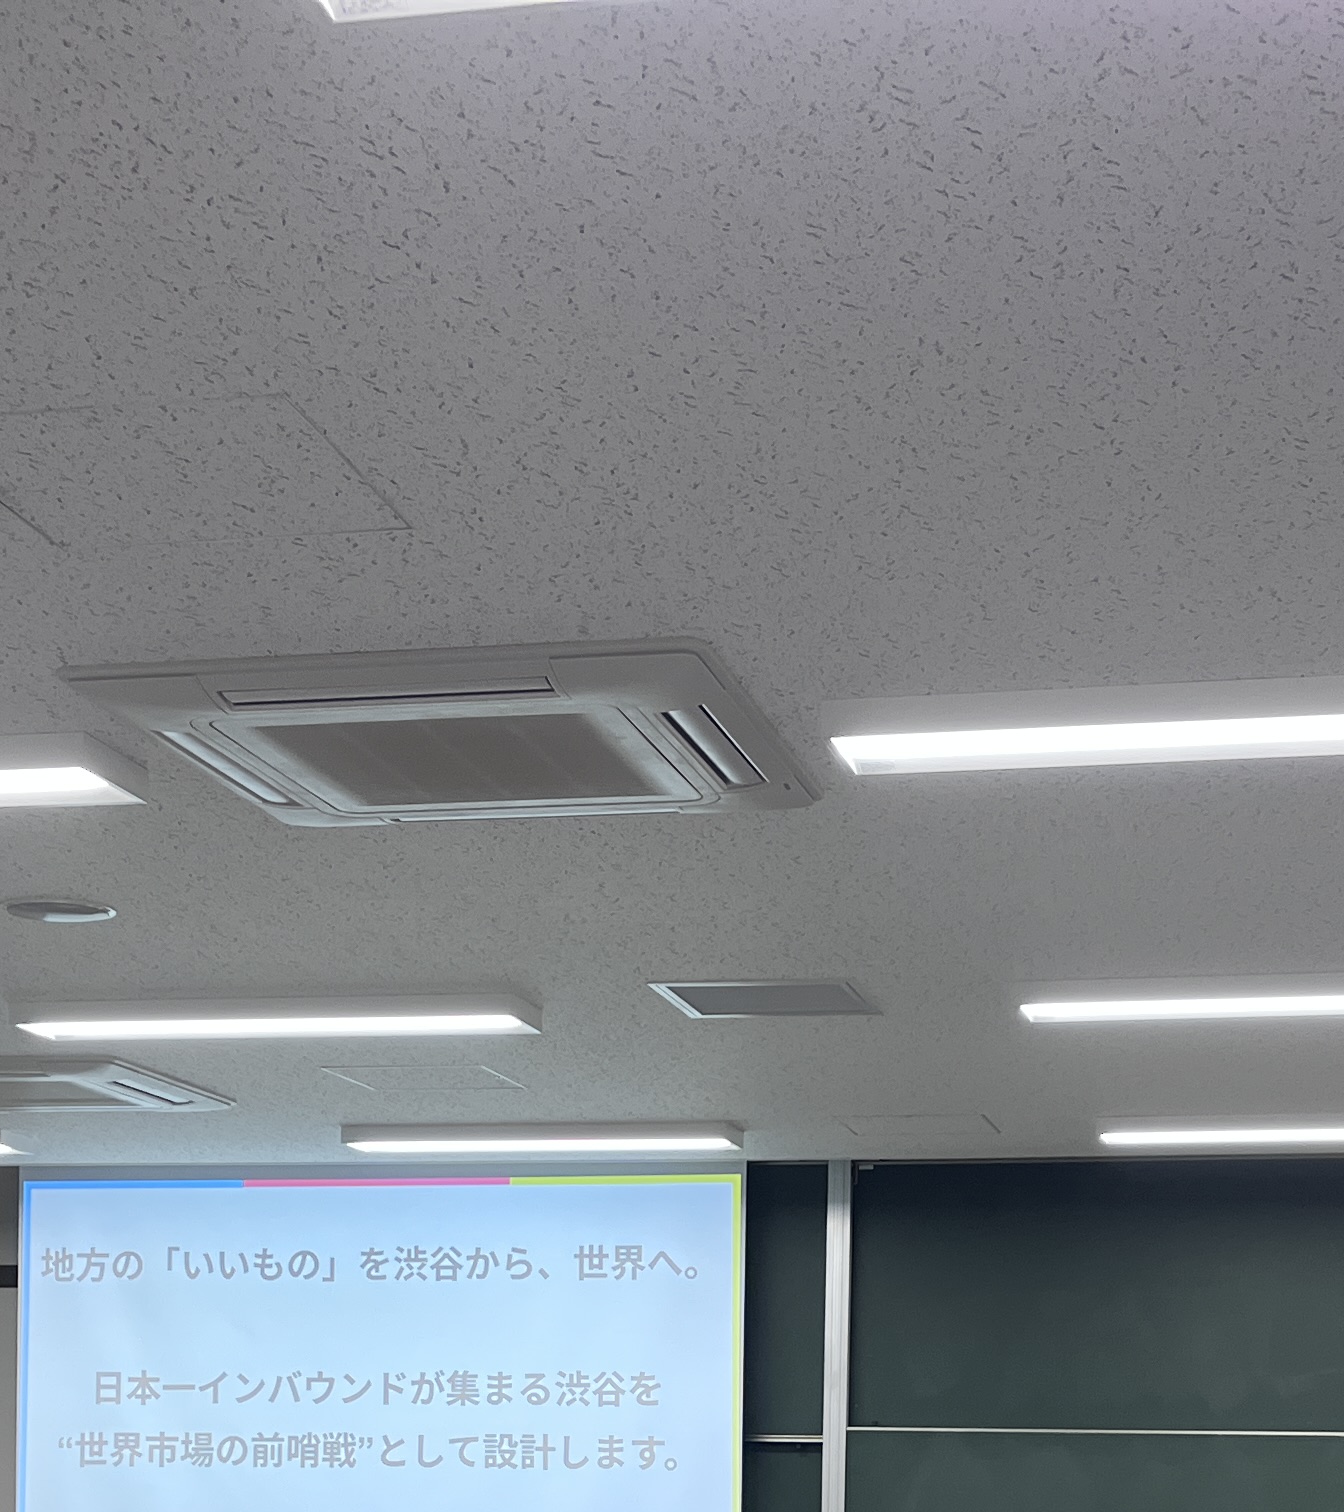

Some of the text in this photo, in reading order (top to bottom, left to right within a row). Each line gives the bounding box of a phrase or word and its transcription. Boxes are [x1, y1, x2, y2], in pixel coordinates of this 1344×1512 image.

[41, 1244, 699, 1284] 地方の「いいもの」を渋谷から、世界へ。
[93, 1369, 661, 1408] 日本一インバウンドが集まる渋谷を
